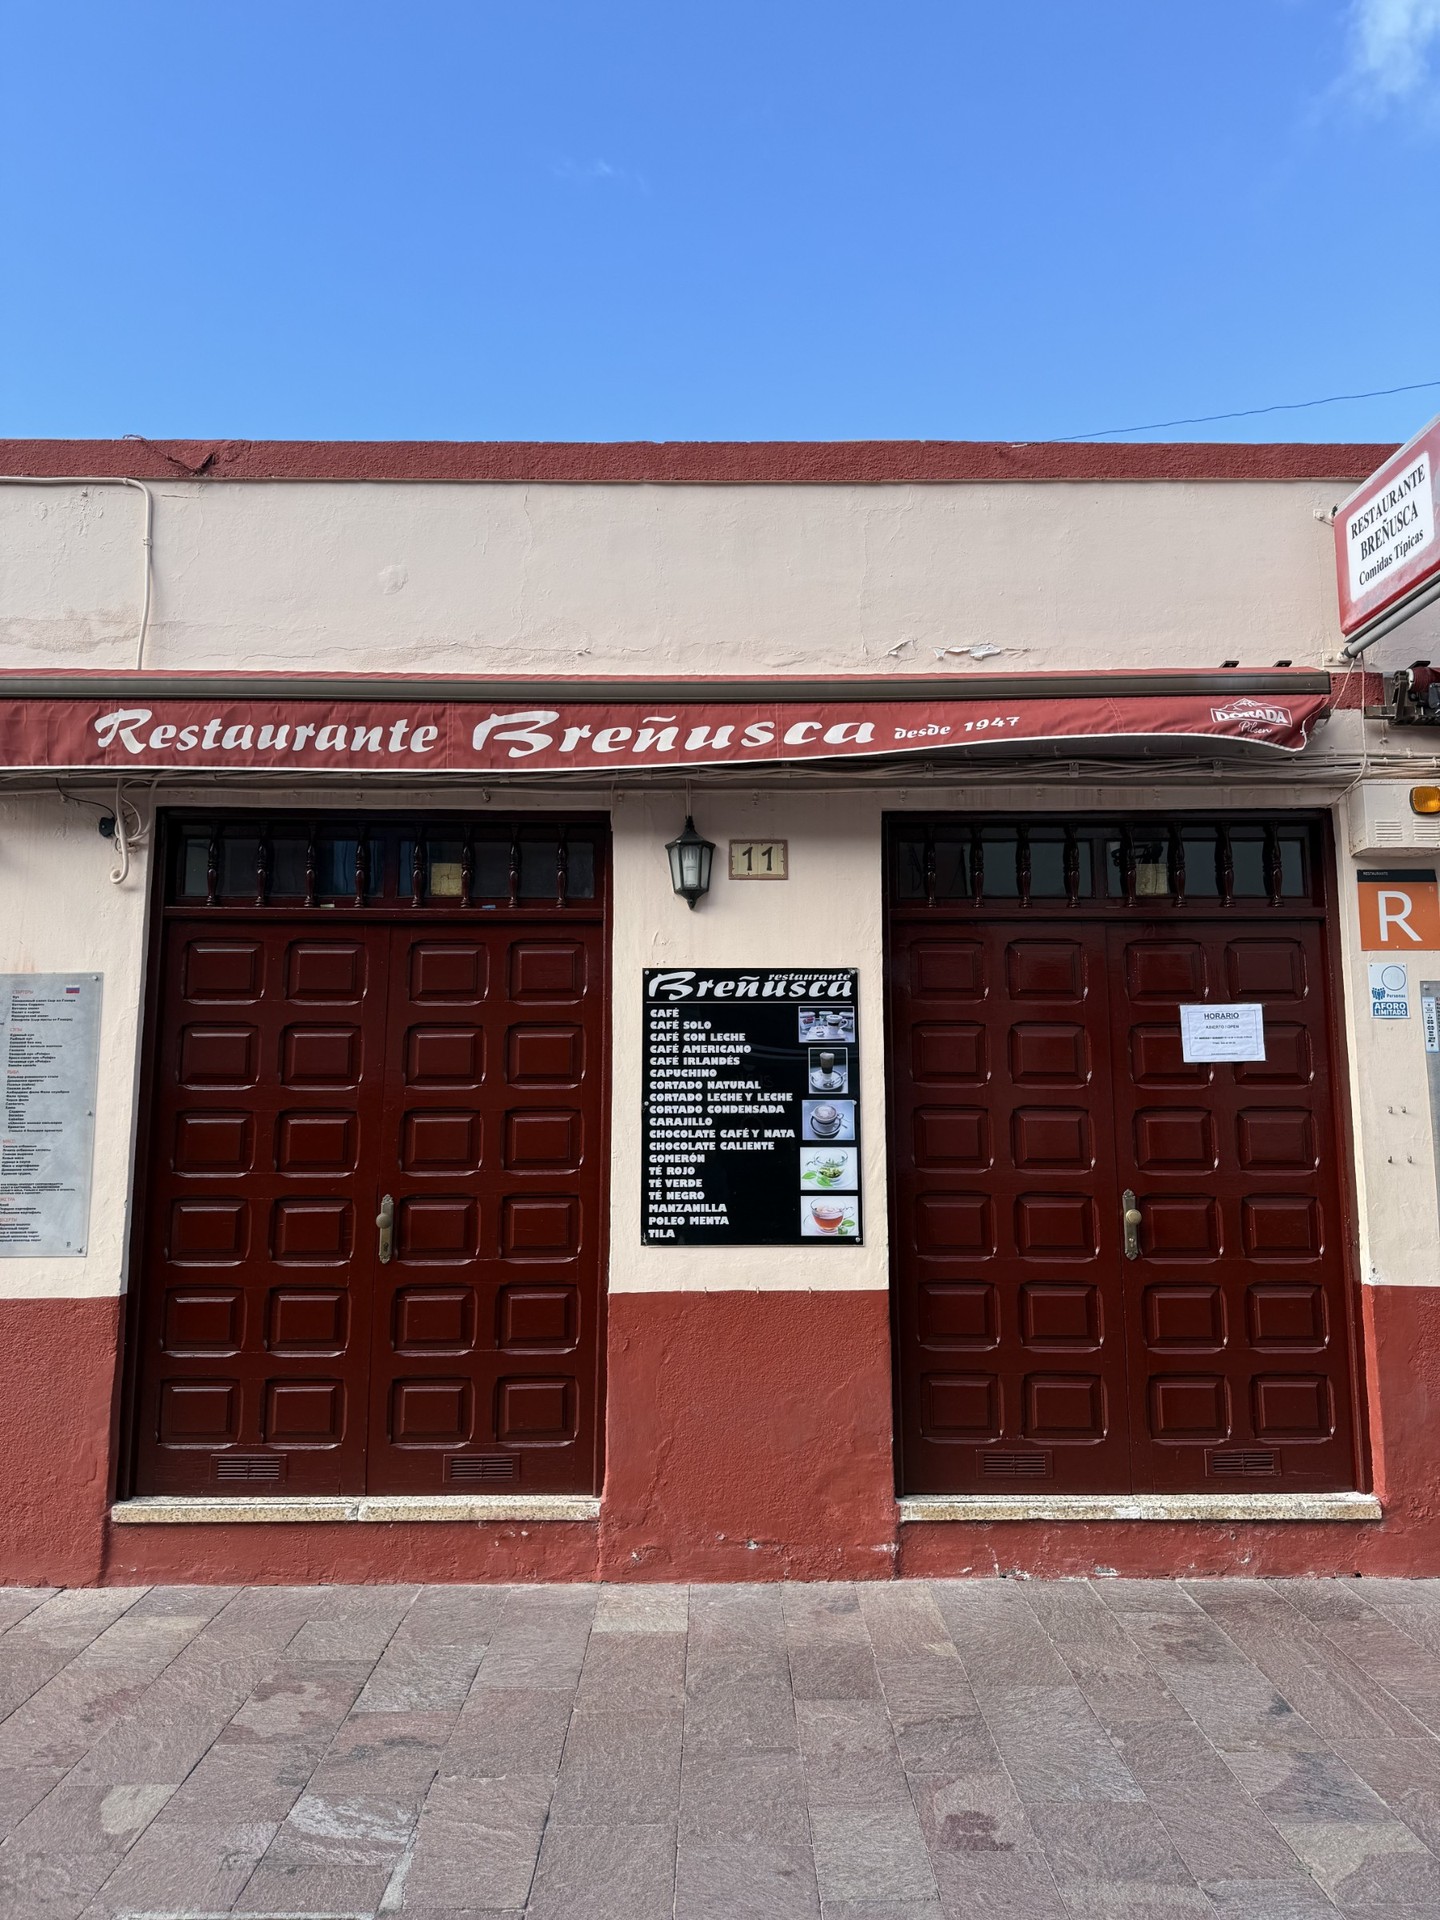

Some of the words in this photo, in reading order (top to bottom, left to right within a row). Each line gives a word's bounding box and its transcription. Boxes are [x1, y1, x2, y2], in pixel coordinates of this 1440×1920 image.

[1351, 464, 1425, 540] RESTAURANTE
[1360, 500, 1418, 561] BREÑUSCA
[1359, 554, 1393, 586] Comidas
[1394, 529, 1424, 558] Típicas
[1215, 709, 1289, 724] DORADA
[1239, 721, 1272, 733] Pilsen
[94, 708, 438, 754] Restaurante
[472, 710, 875, 758] Breñusca
[894, 724, 951, 739] desde
[964, 716, 1020, 732] 1947
[742, 846, 773, 871] 11
[1377, 890, 1423, 942] R
[768, 973, 851, 981] restaurante
[648, 971, 852, 1000] Breñusca
[1374, 1002, 1406, 1010] AFORO
[650, 1007, 679, 1018] CAFÉ
[1204, 1012, 1239, 1020] HORARIO
[650, 1019, 679, 1030] CAFÉ
[683, 1021, 712, 1030] SOLO
[650, 1031, 679, 1041] CAFÉ
[683, 1033, 706, 1041] CON
[710, 1033, 746, 1041] LECHE
[650, 1043, 679, 1053] CAFÉ
[682, 1045, 752, 1053] AMERICANO
[650, 1055, 679, 1065] CAFÉ
[683, 1055, 740, 1065] IRLANDÉS
[649, 1068, 717, 1077] CAPUCHINO
[649, 1080, 703, 1090] CORTADO
[707, 1080, 761, 1090] NATURAL
[649, 1092, 703, 1102] CORTADO
[707, 1092, 743, 1102] LECHE
[745, 1092, 753, 1102] Y
[757, 1092, 793, 1102] LECHE
[649, 1105, 703, 1114] CORTADO
[707, 1105, 785, 1114] CONDENSADA
[649, 1117, 713, 1126] CARAJILLO
[649, 1129, 716, 1138] CHOCOLATE
[720, 1128, 750, 1138] CAFÉ
[751, 1129, 760, 1138] Y
[764, 1129, 796, 1138] NATA
[649, 1141, 716, 1150] CHOCOLATE
[720, 1141, 775, 1150] CALIENTE
[649, 1152, 705, 1163] GOMERÓN
[649, 1165, 663, 1175] TÉ
[666, 1167, 696, 1175] ROJO
[649, 1177, 663, 1188] TÉ
[665, 1179, 703, 1188] VERDE
[649, 1190, 663, 1200] TÉ
[666, 1191, 705, 1200] NEGRO
[648, 1203, 728, 1213] MANZANILLA
[648, 1216, 686, 1226] POLEO
[689, 1216, 730, 1226] MENTA
[648, 1228, 676, 1238] TILA
